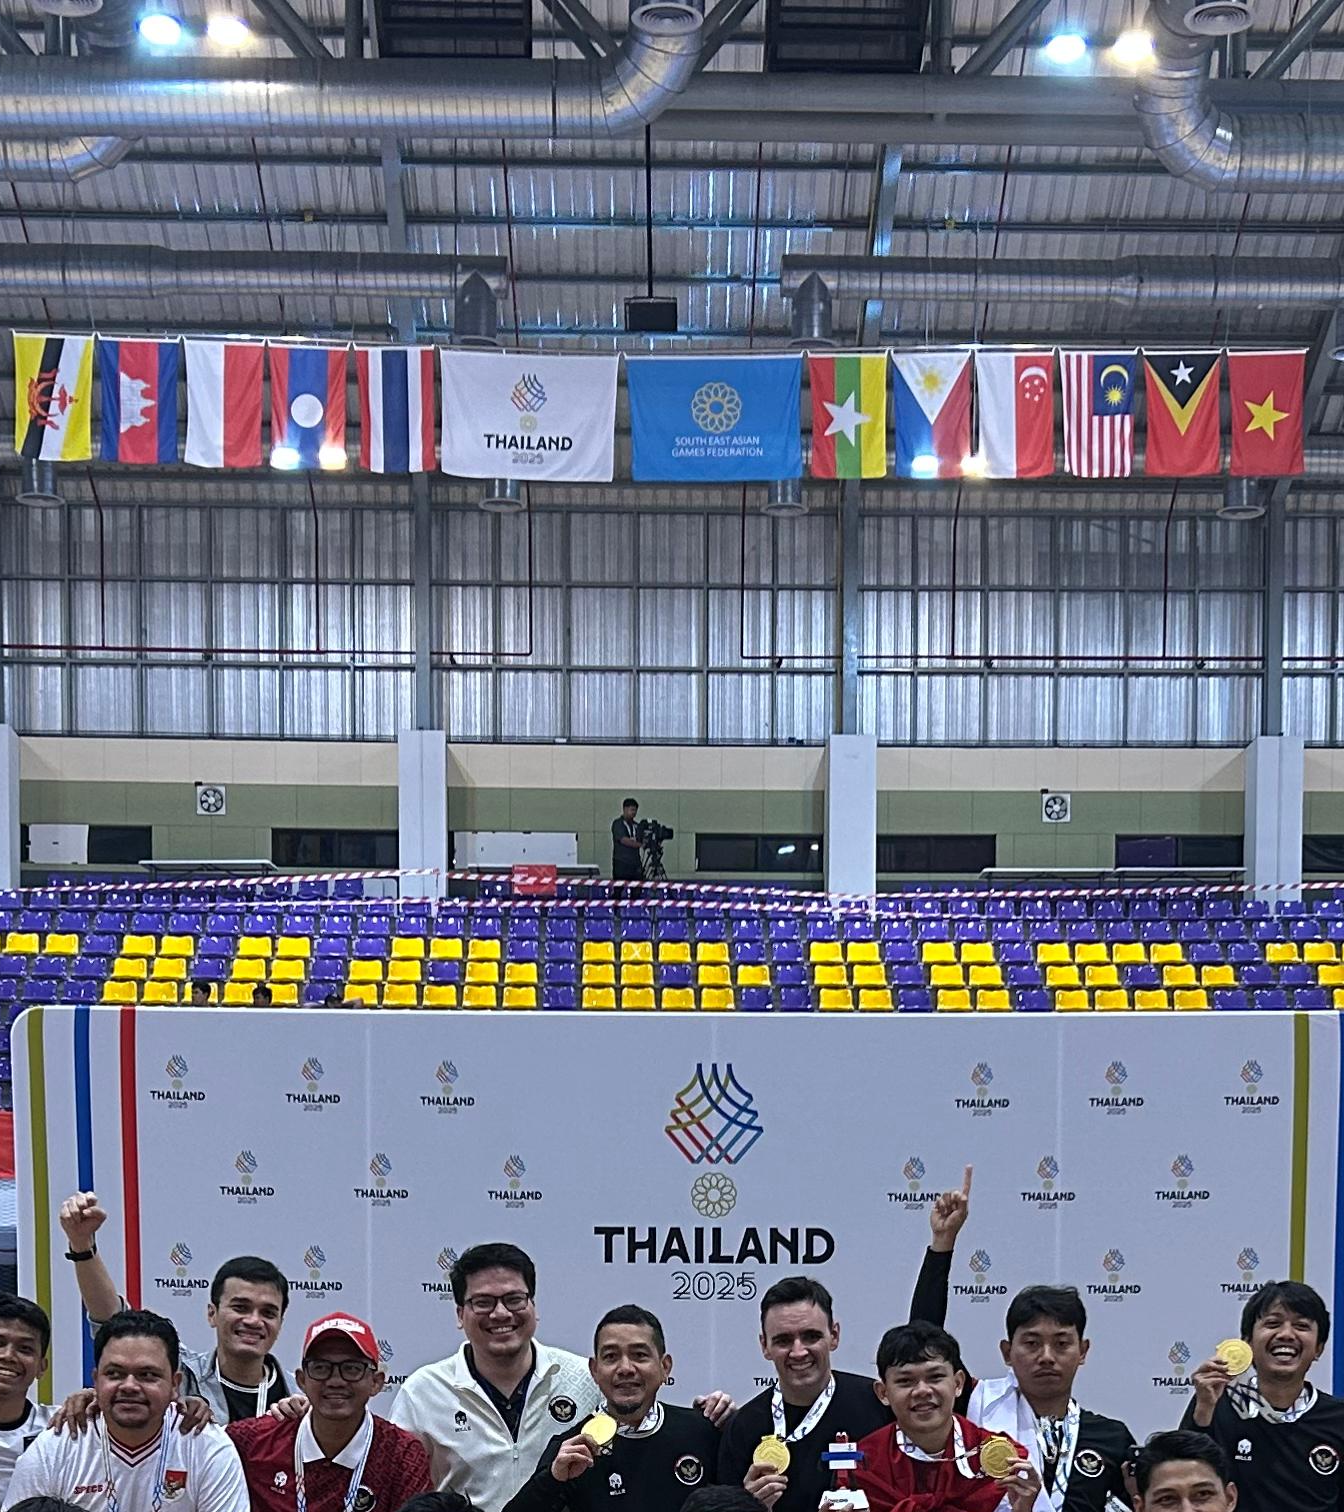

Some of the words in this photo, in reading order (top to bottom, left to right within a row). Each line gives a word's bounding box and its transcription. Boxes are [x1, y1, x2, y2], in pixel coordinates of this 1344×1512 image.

[484, 434, 573, 451] THAILAND
[674, 436, 706, 447] SOUTH
[708, 436, 731, 446] EAST
[732, 435, 760, 445] ASIAN
[672, 447, 705, 458] GAMES
[707, 447, 763, 457] FEDERATION
[150, 1091, 205, 1101] THAILAND
[286, 1094, 341, 1104] THAILAND
[421, 1096, 476, 1106] THAILAND
[1224, 1096, 1279, 1106] THAILAND
[955, 1099, 1010, 1109] THAILAND
[1089, 1098, 1144, 1108] THAILAND
[220, 1186, 275, 1196] THAILAND
[354, 1189, 409, 1199] THAILAND
[488, 1190, 543, 1200] THAILAND
[1155, 1191, 1210, 1201] THAILAND
[1021, 1192, 1076, 1202] THAILAND
[594, 1227, 835, 1264] THAILAND
[155, 1279, 209, 1289] THAILAND
[288, 1281, 342, 1291] THAILAND
[422, 1283, 452, 1293] THAIL
[671, 1271, 757, 1300] 2025
[953, 1286, 1008, 1296] THAILAND
[1087, 1285, 1142, 1295] THAILAND
[1152, 1377, 1194, 1387] THAILA
[74, 1485, 103, 1494] SPECS
